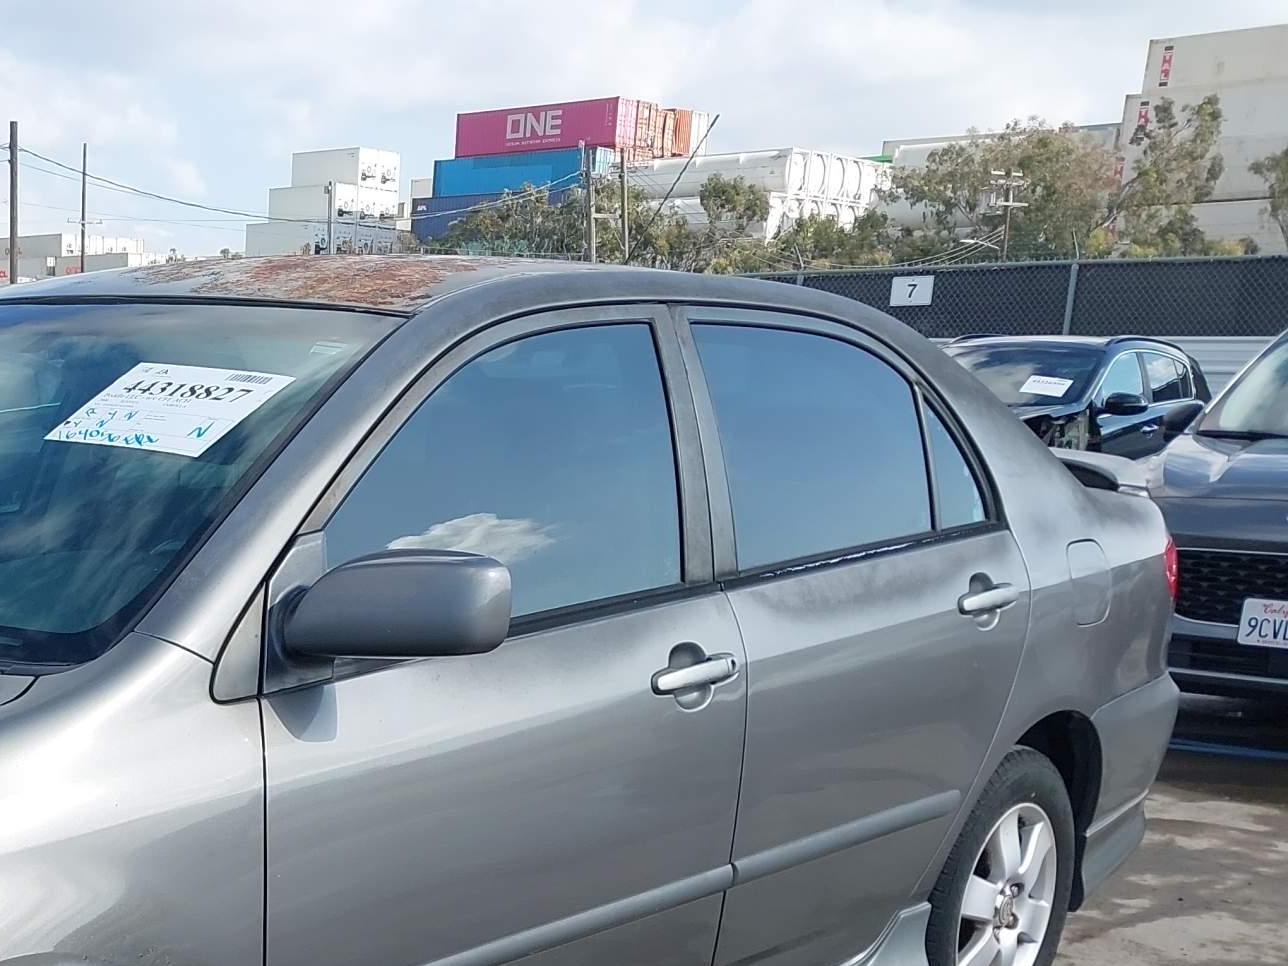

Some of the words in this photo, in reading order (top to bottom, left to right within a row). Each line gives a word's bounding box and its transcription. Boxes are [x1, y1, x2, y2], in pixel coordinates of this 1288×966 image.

[506, 110, 562, 139] ONE
[907, 284, 918, 299] 7
[123, 379, 255, 403] 44318827
